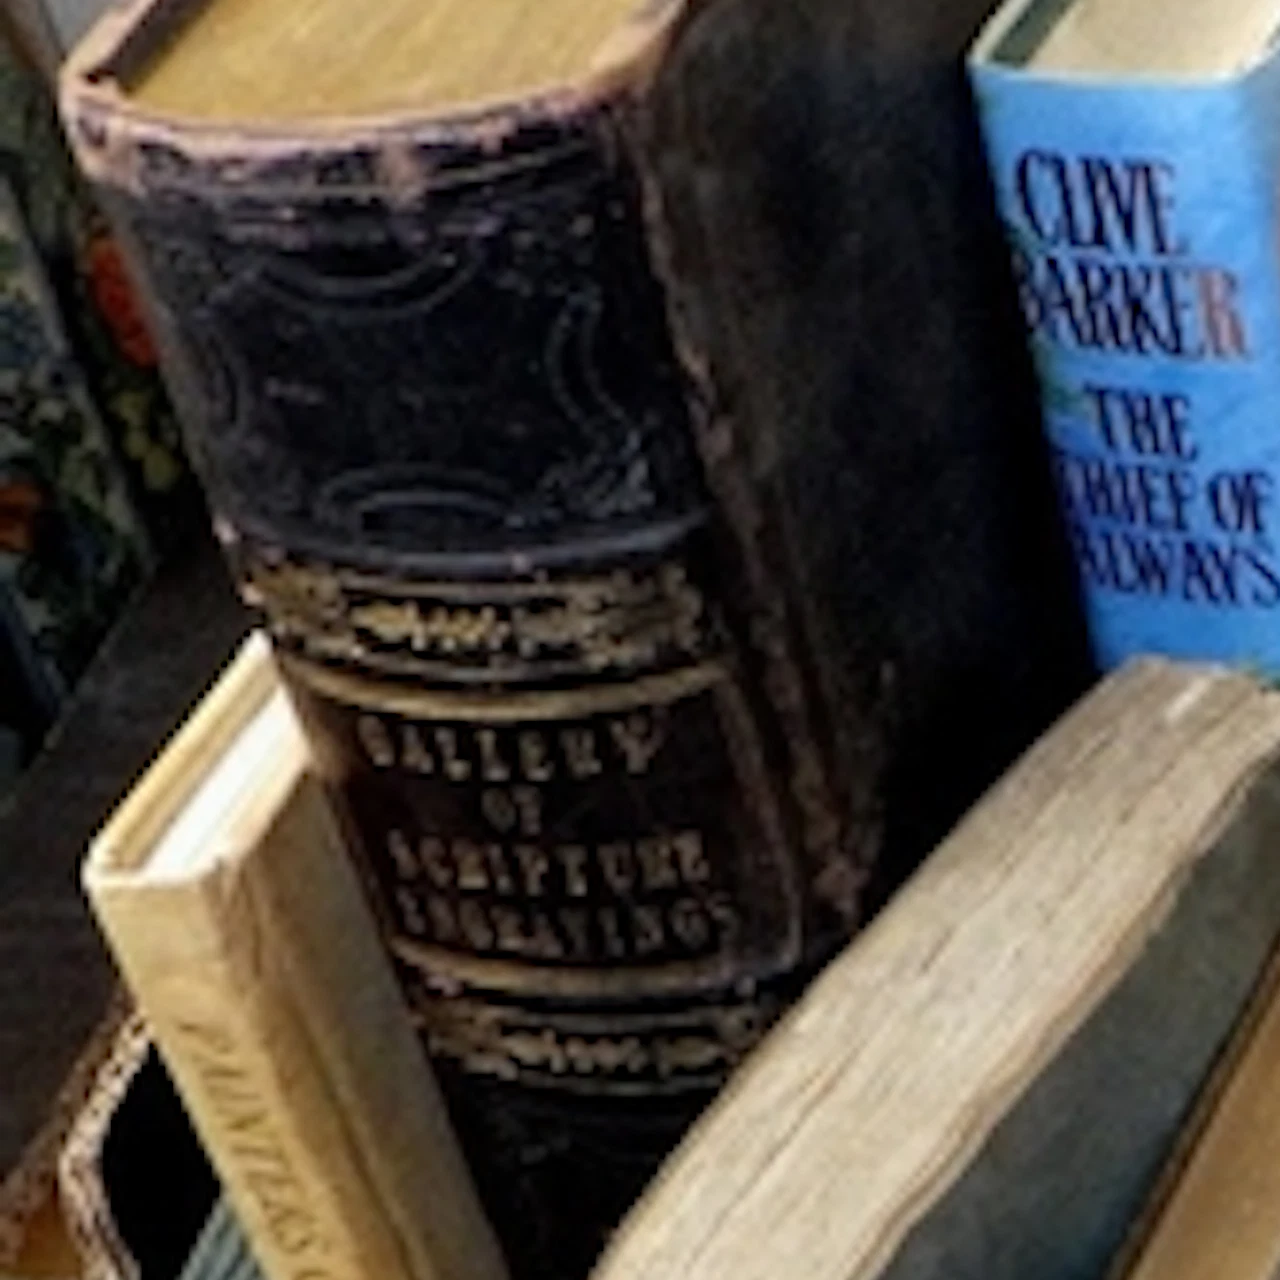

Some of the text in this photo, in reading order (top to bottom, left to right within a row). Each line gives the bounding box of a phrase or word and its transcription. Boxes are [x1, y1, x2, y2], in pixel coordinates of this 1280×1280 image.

[1014, 148, 1186, 256] CLIVE
[1082, 384, 1200, 462] THE
[1206, 468, 1274, 538] OF
